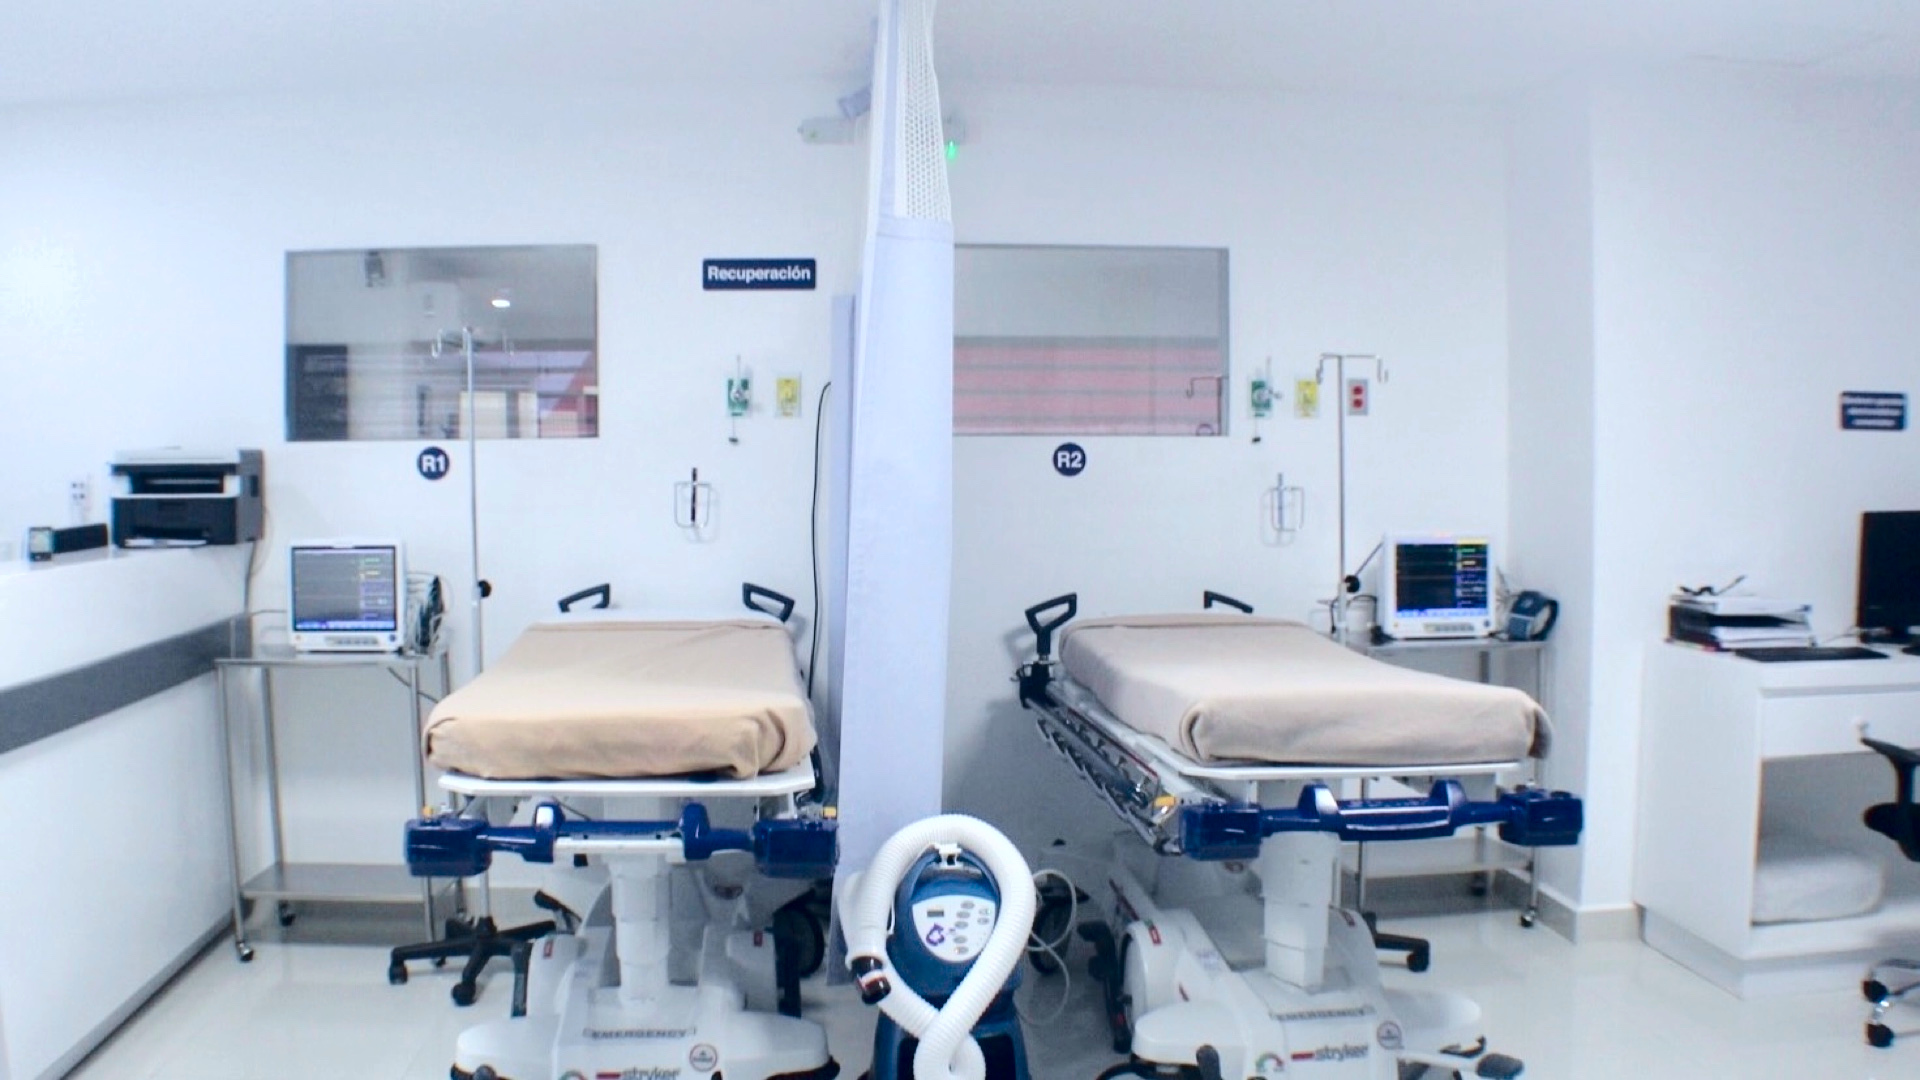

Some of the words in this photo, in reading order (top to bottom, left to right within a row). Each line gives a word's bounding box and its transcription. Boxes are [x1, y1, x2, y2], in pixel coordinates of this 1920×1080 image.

[707, 265, 811, 284] Recuperación
[422, 454, 446, 472] R1
[1057, 451, 1082, 468] R2
[591, 1029, 688, 1039] EMERGENCY
[1315, 1044, 1369, 1061] stryker
[621, 1066, 681, 1080] stryker
